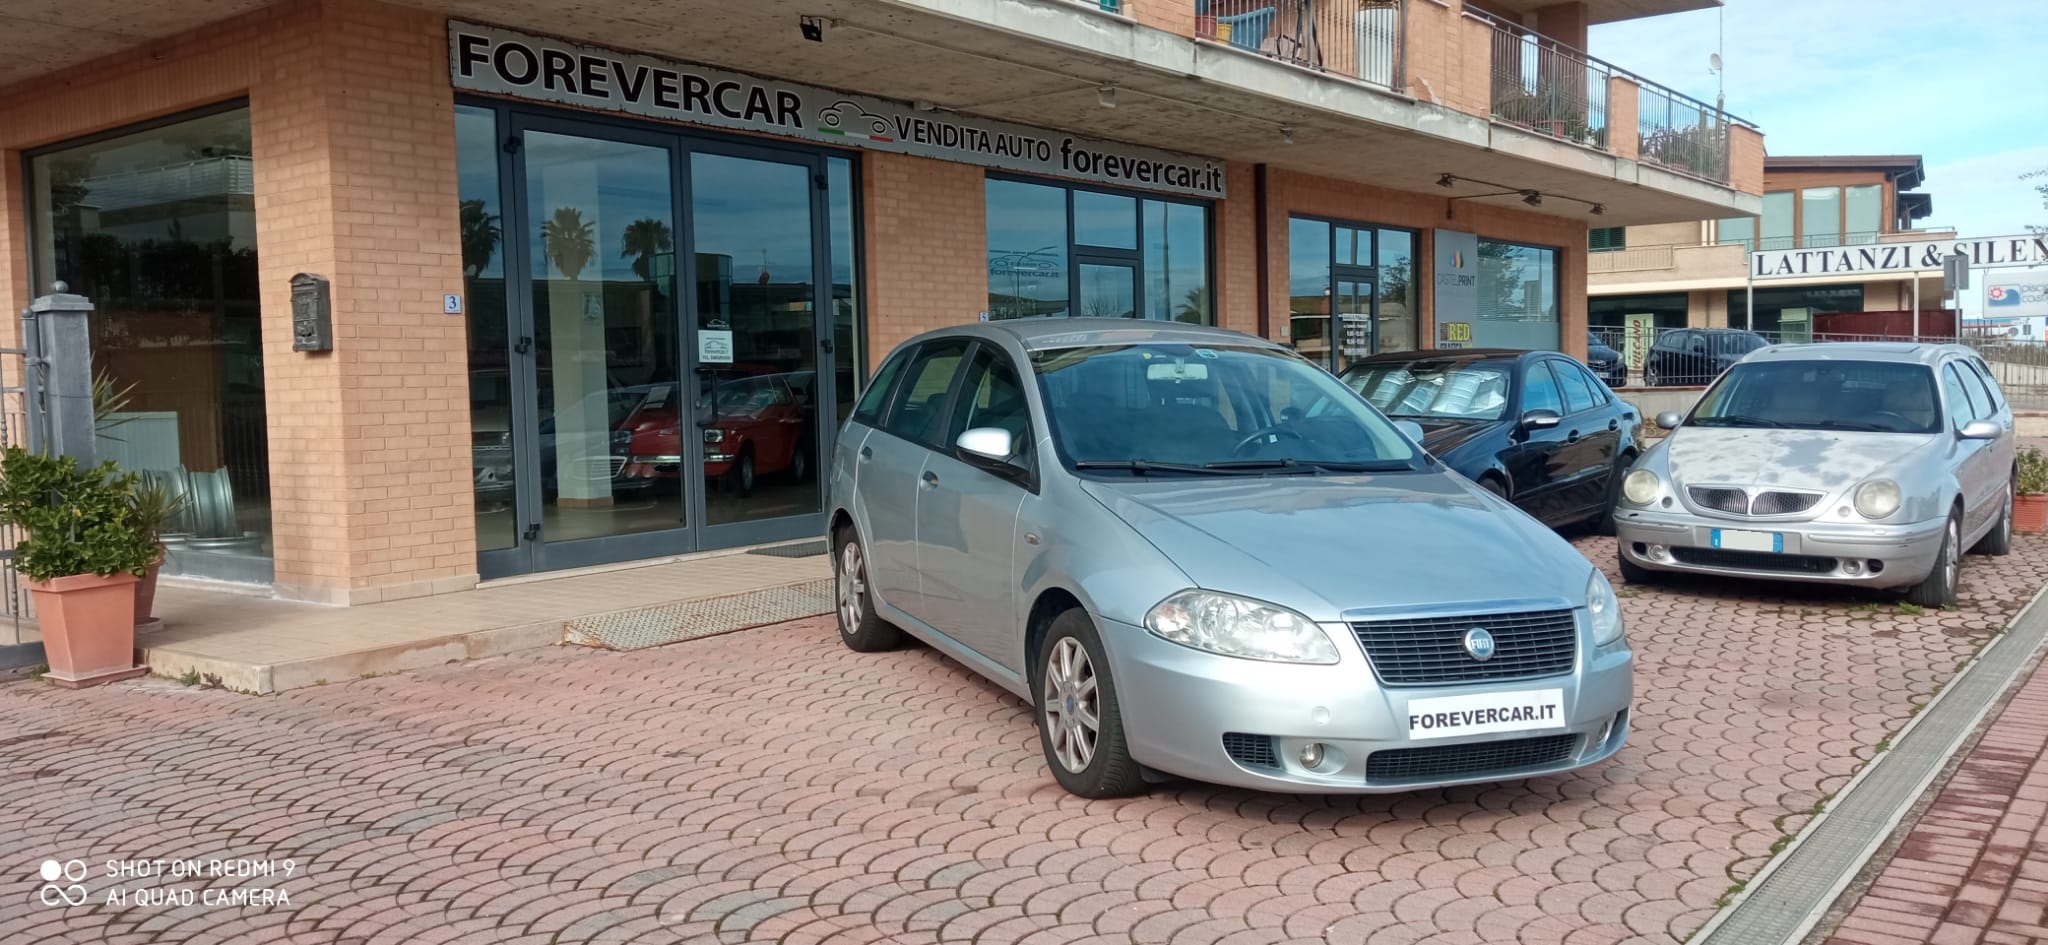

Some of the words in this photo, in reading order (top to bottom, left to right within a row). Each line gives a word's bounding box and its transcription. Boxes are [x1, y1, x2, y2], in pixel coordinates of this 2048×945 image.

[457, 32, 804, 129] FOREVERCAR
[894, 115, 991, 154] VENDITA
[994, 132, 1051, 162] AUTO
[1059, 137, 1222, 194] forevercar.it
[1755, 245, 1912, 276] LATTANZI
[1920, 244, 1944, 268] &
[449, 296, 456, 309] 3
[1449, 323, 1470, 341] RED
[1632, 319, 1642, 370] VULCANO
[1470, 638, 1491, 650] FIAT
[1409, 704, 1556, 730] FOREVERCAR.IT
